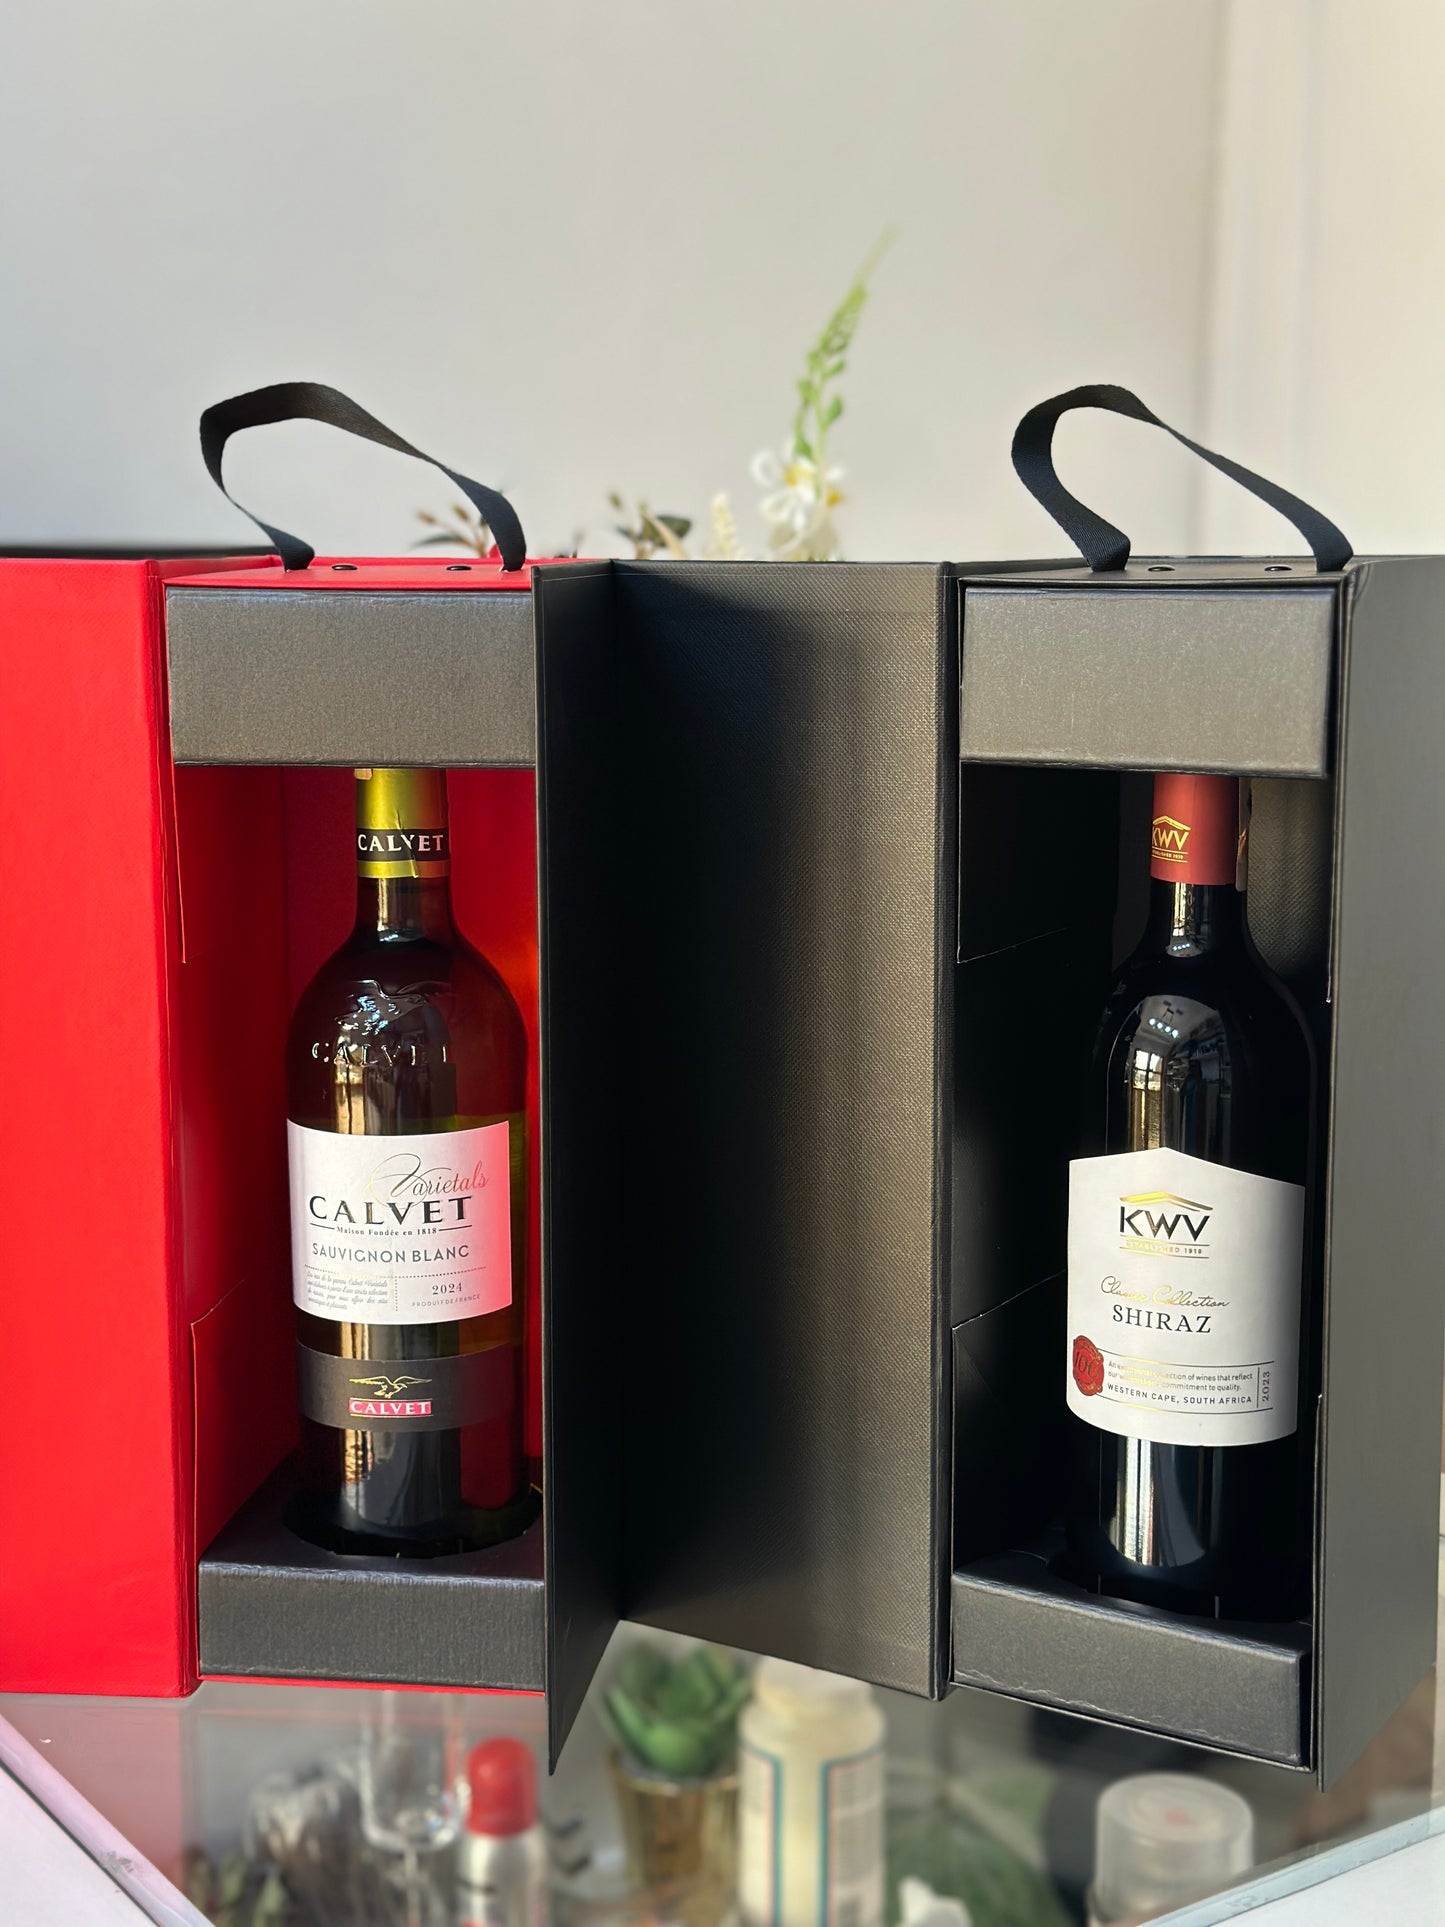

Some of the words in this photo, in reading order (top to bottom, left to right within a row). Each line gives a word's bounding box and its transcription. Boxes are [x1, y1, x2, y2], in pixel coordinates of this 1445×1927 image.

[357, 833, 444, 852] CALVET
[1151, 826, 1189, 850] KWV
[371, 1153, 489, 1207] Varietals
[309, 1195, 473, 1226] CALVET
[336, 1226, 365, 1236] Maison
[368, 1227, 400, 1237] Fondée
[417, 1227, 438, 1236] 1818
[1119, 1206, 1210, 1242] KWV
[312, 1242, 406, 1263] SAUVIGNON
[412, 1244, 470, 1263] BLANC
[432, 1282, 462, 1295] 2024
[455, 1294, 480, 1303] FRANCE
[1152, 1285, 1230, 1307] Collection
[1112, 1304, 1212, 1333] SHIRAZ
[1188, 1372, 1195, 1380] of
[1196, 1373, 1216, 1382] wines
[1217, 1373, 1230, 1381] that
[1261, 1371, 1271, 1402] 2023
[1107, 1383, 1148, 1399] WESTERN
[1151, 1393, 1180, 1404] CAPE,
[1183, 1396, 1216, 1405] SOUTH
[1218, 1396, 1252, 1405] AFRICA
[350, 1401, 429, 1415] CALVET
